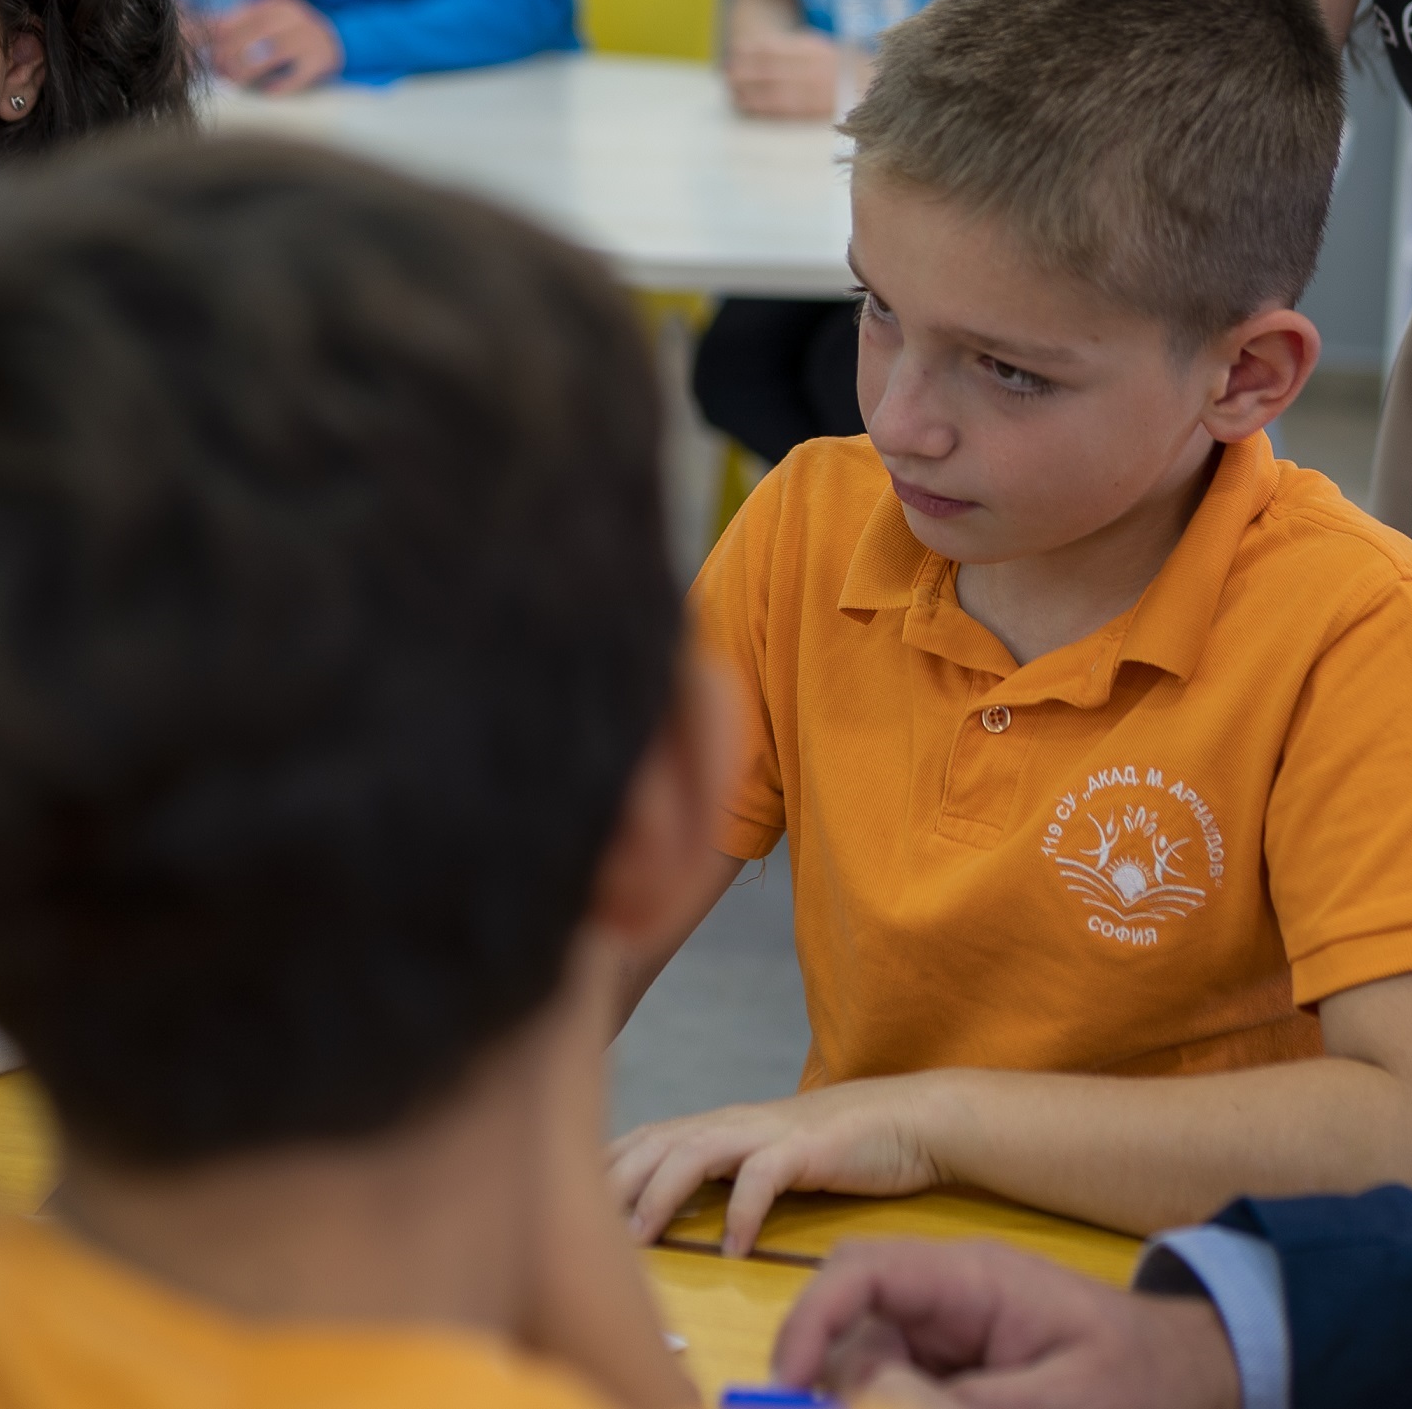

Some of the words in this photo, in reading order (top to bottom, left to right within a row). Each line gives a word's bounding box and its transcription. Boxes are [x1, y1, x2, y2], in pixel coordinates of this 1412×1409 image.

[1041, 823, 1063, 857] 119
[1055, 792, 1076, 821] СУ
[1088, 914, 1158, 946] СОФИЯ
